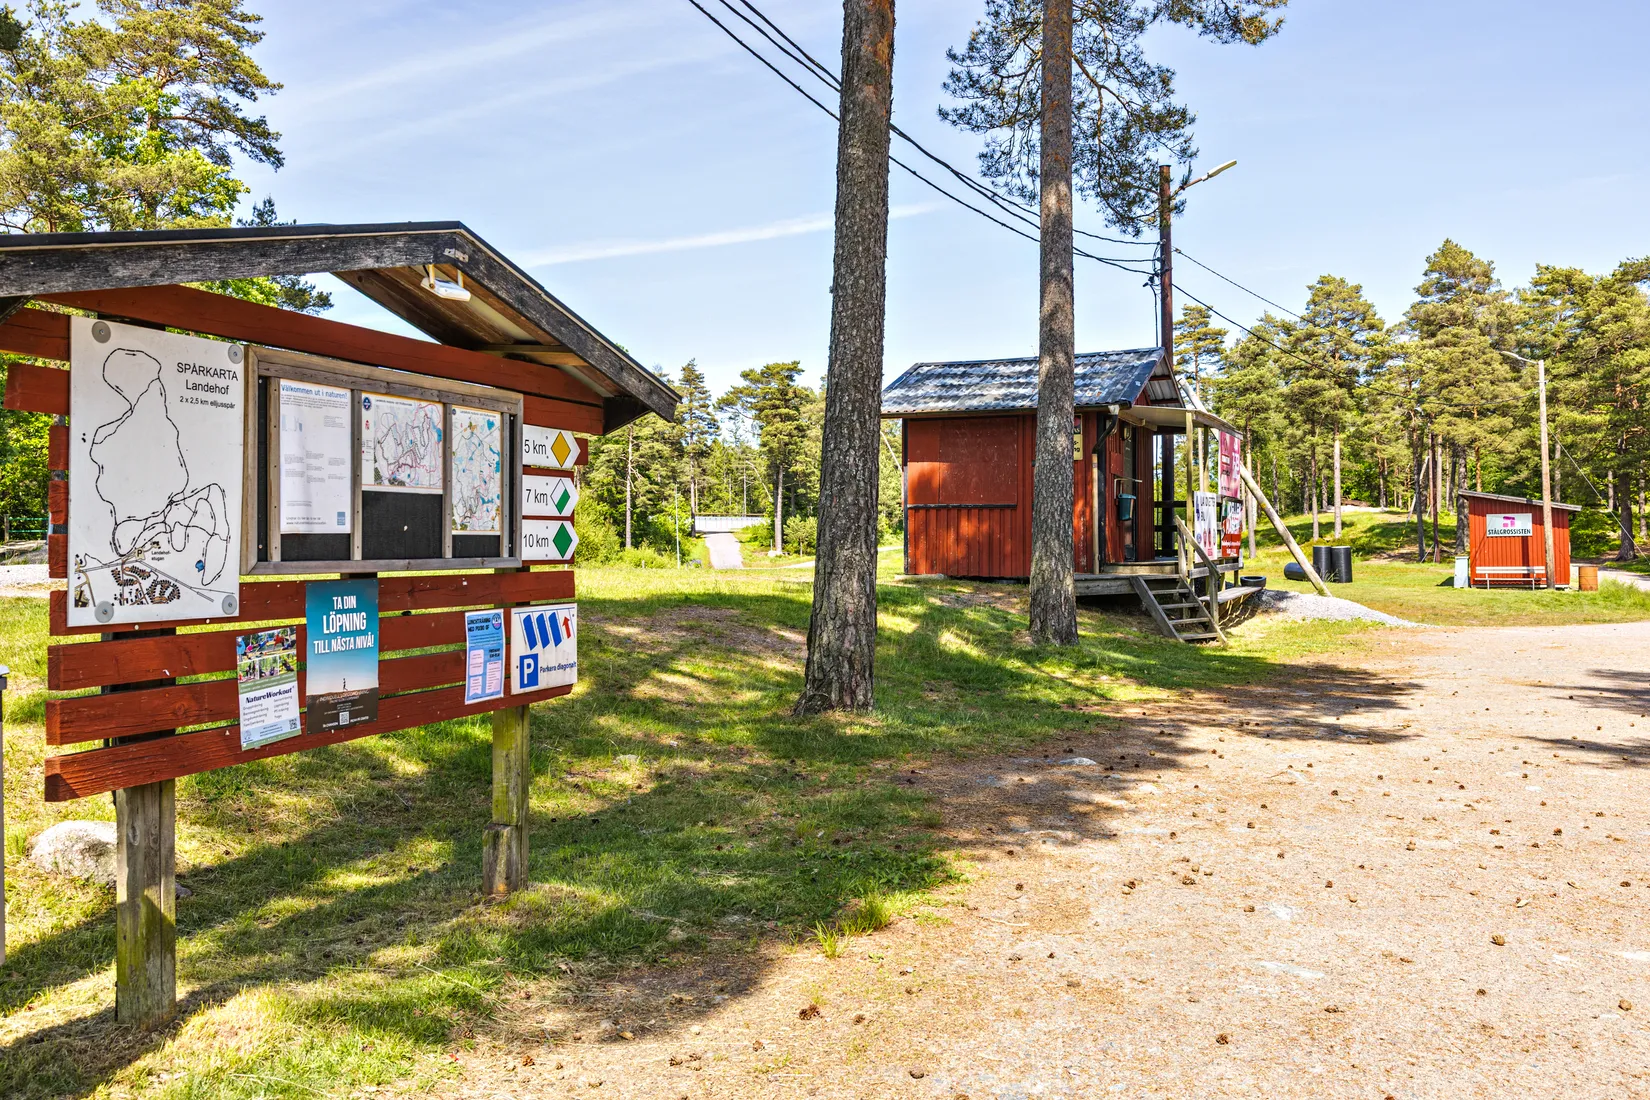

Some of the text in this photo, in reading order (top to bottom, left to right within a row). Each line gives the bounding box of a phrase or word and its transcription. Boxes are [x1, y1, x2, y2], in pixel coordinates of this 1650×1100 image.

[176, 361, 239, 382] SPÅRKARTA
[185, 379, 229, 395] Landehof
[281, 384, 313, 395] Välkommen
[179, 395, 184, 403] 2
[190, 396, 199, 405] 2,5
[200, 398, 209, 406] km
[524, 439, 547, 455] 5 km
[525, 489, 548, 504] 7 km
[1487, 528, 1531, 536] STÅLGROSSISTEN
[523, 533, 549, 548] 10 km
[137, 549, 143, 557] P
[332, 595, 357, 610] TA DIN
[323, 611, 367, 634] LÖPNING
[313, 631, 375, 655] TILL NÄSTA NIVÅ!
[523, 657, 535, 685] P
[539, 660, 577, 674] Parkera diagonalt
